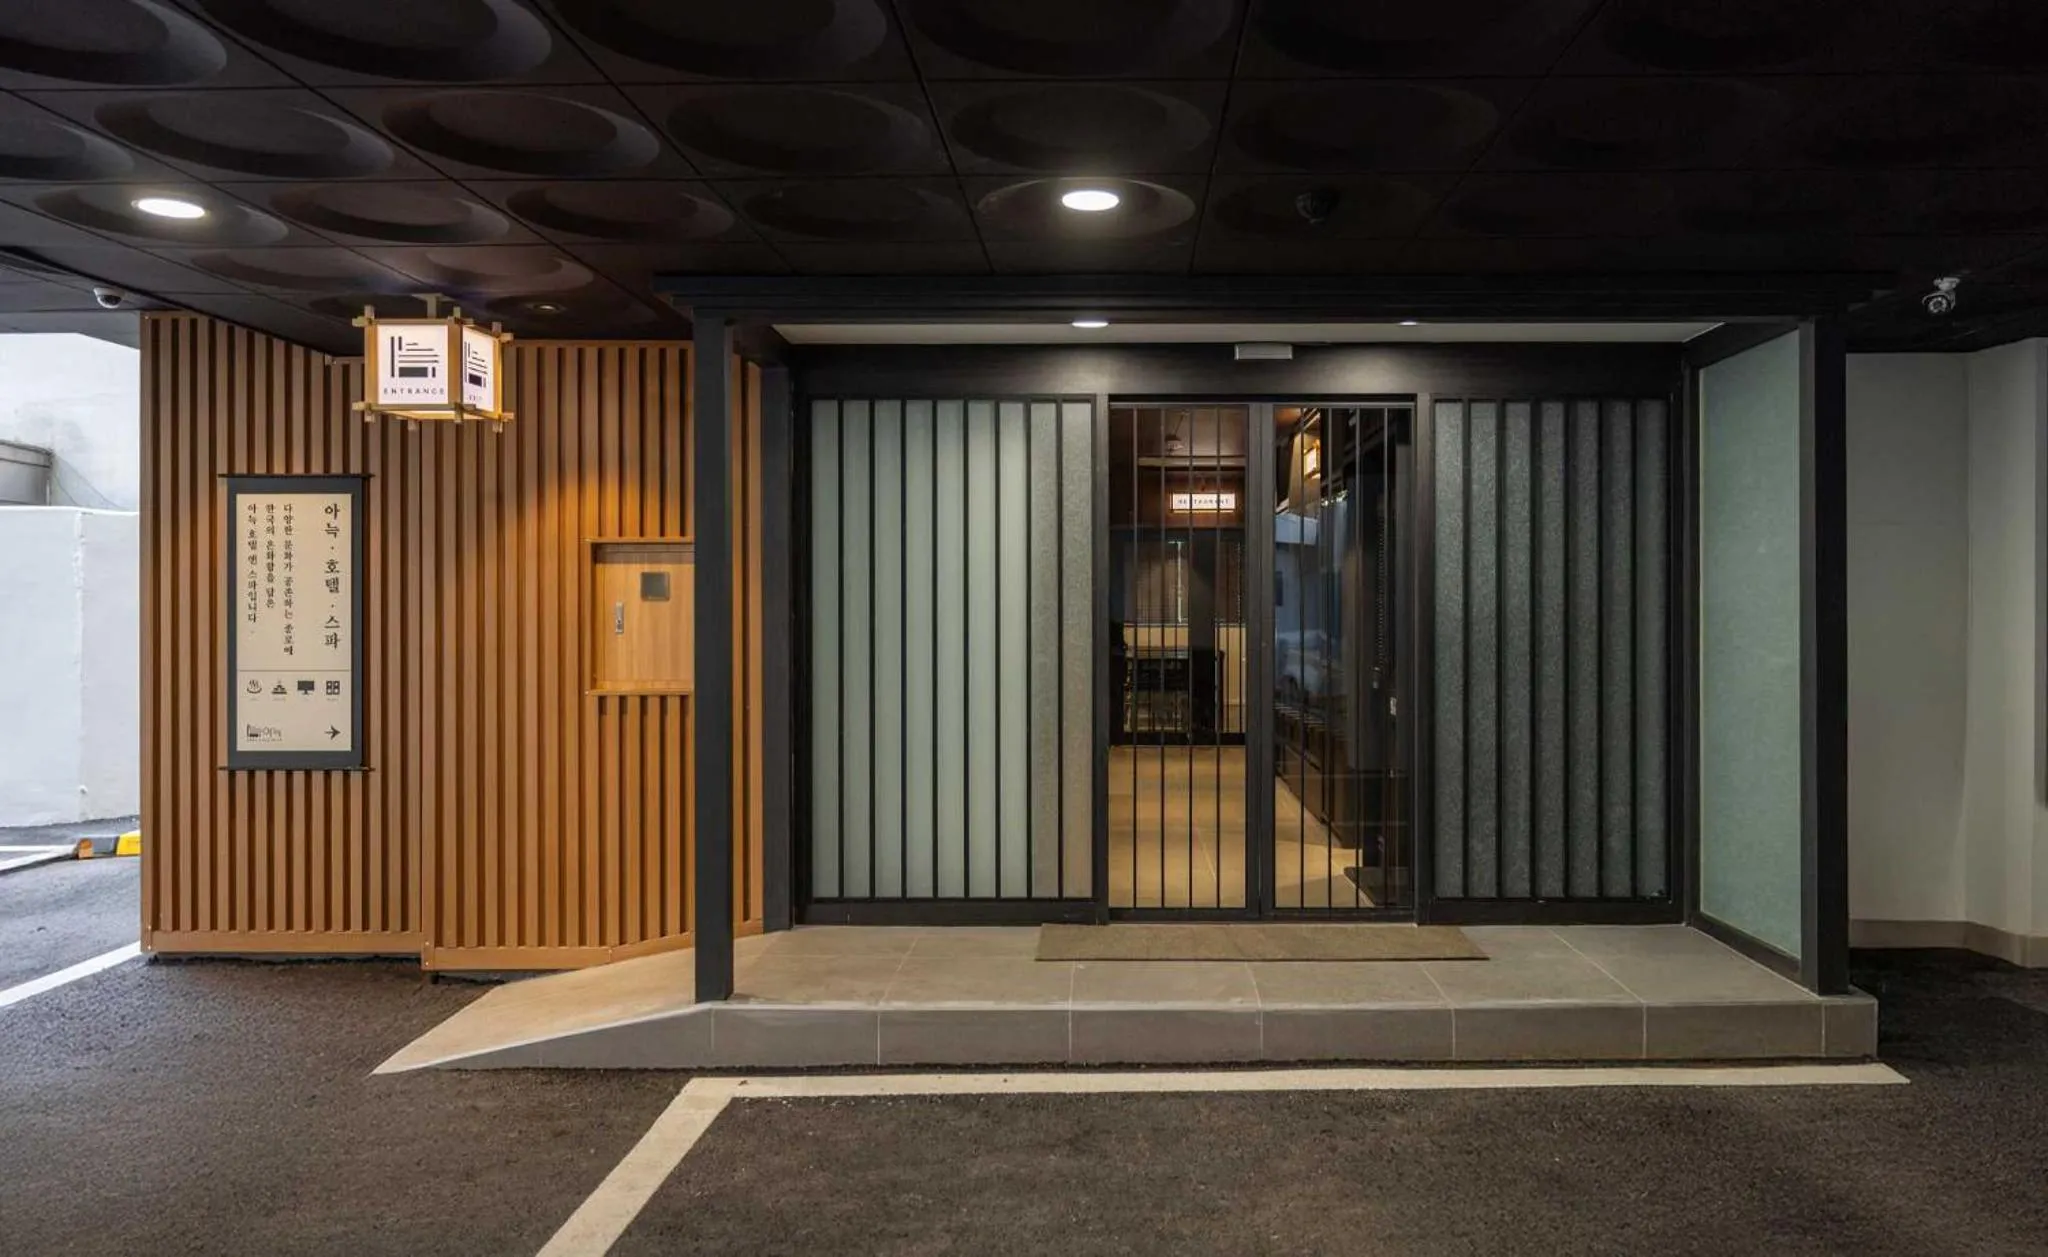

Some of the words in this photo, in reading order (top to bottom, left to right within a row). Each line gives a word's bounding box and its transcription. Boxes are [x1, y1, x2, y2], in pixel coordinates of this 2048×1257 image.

[383, 387, 445, 396] ENTRANCE
[247, 503, 257, 525] 아늑
[283, 503, 293, 536] 다양한
[324, 503, 341, 539] 아늑
[247, 529, 257, 551] 호텔
[324, 558, 341, 594] 호텔
[324, 615, 341, 650] 스파
